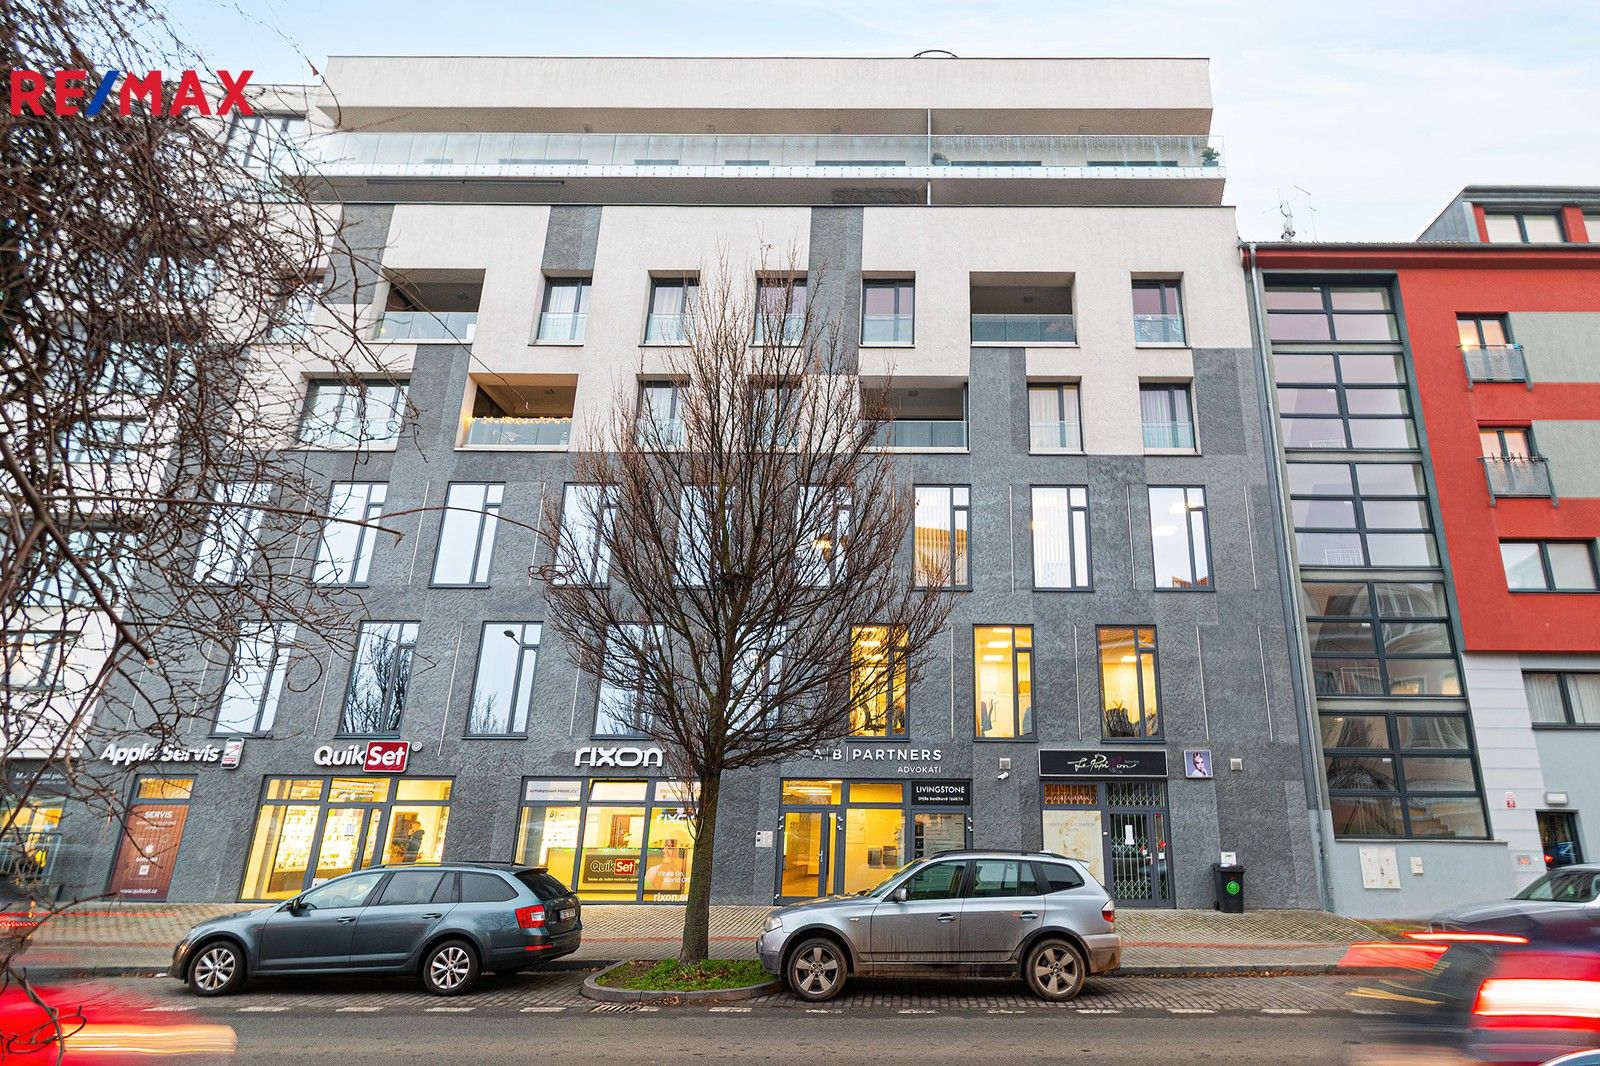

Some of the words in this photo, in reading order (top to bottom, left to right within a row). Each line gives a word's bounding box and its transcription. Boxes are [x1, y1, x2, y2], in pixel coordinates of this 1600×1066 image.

[99, 742, 158, 766] Apple
[160, 744, 221, 762] Servis
[852, 749, 942, 761] PARTNERS
[897, 765, 942, 774] ADVOKÁTI
[915, 786, 966, 794] LIVINGSTONE
[143, 810, 174, 819] SERVIS
